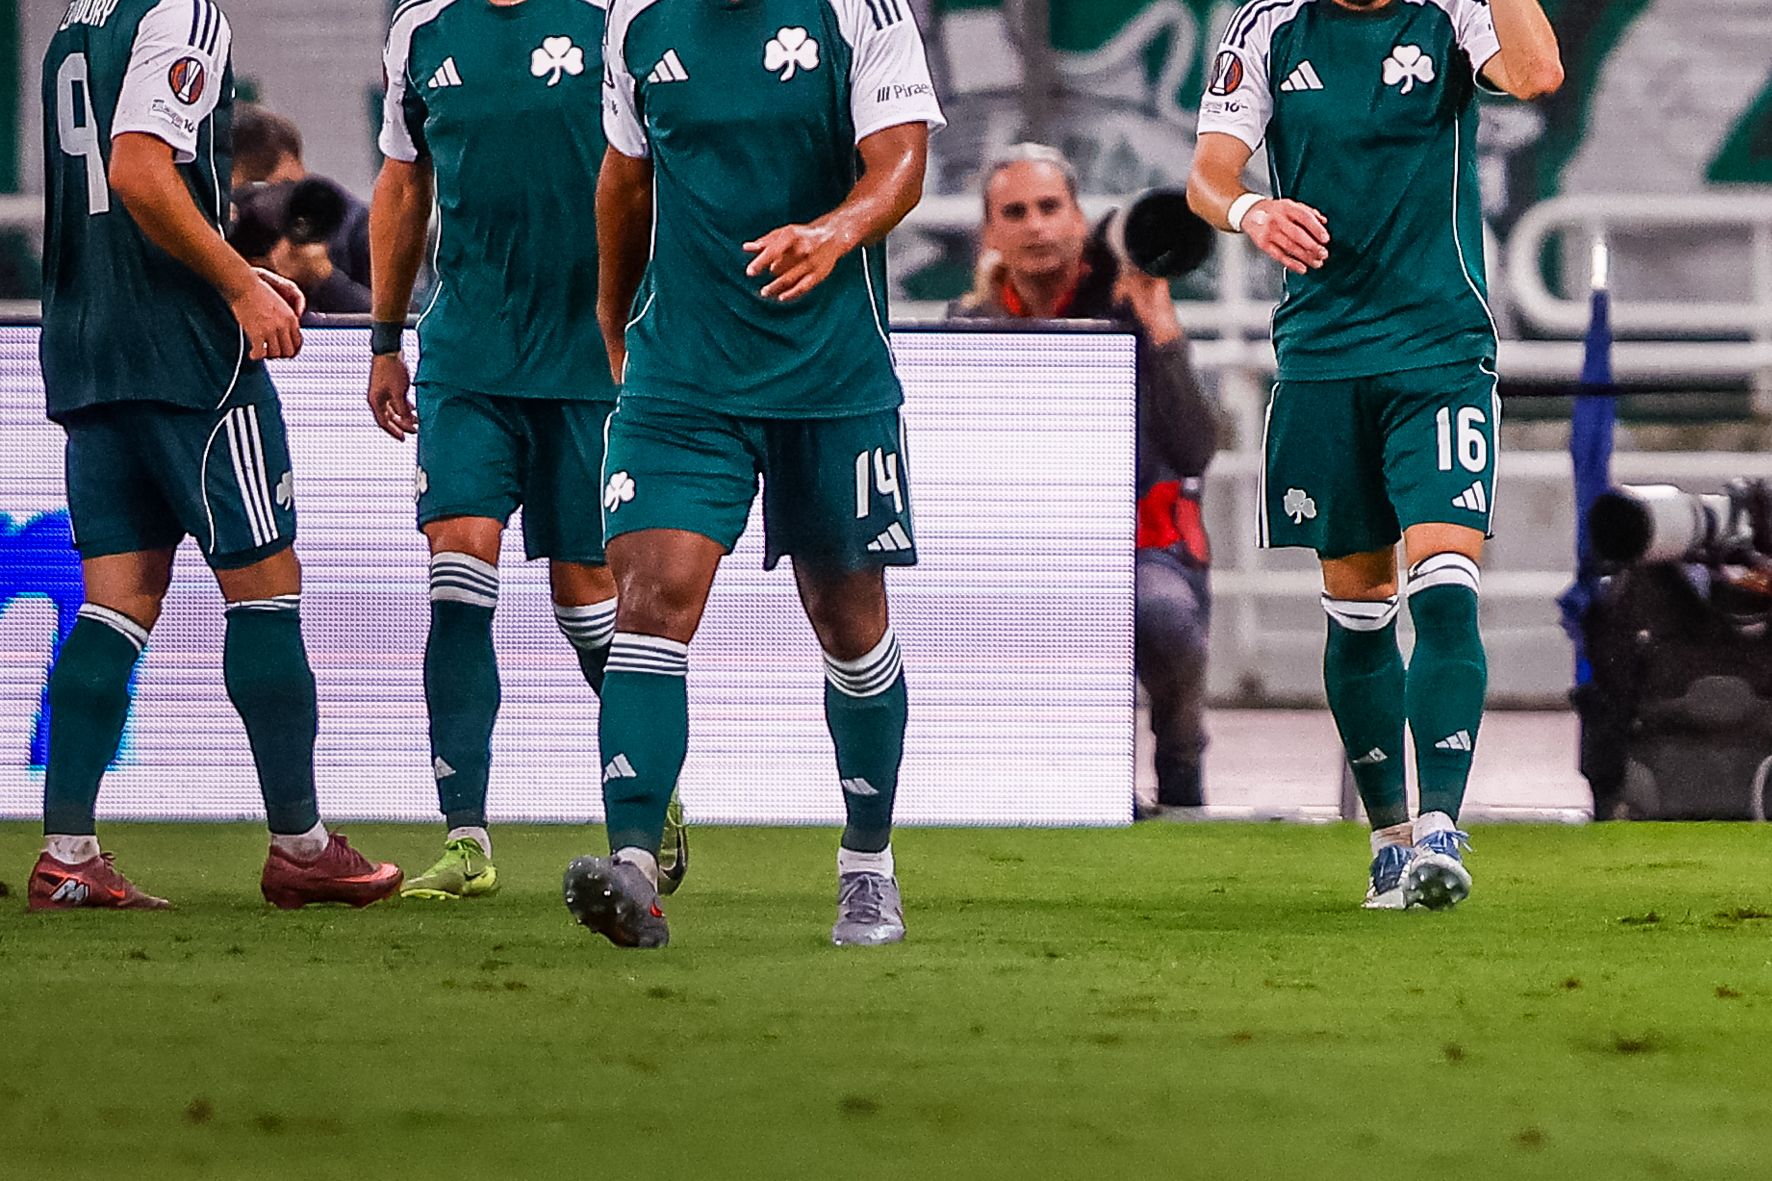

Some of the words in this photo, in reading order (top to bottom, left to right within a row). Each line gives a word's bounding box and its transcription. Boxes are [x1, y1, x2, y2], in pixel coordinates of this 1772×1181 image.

[57, 51, 110, 216] 9
[1435, 405, 1488, 473] 16
[854, 446, 904, 519] 14
